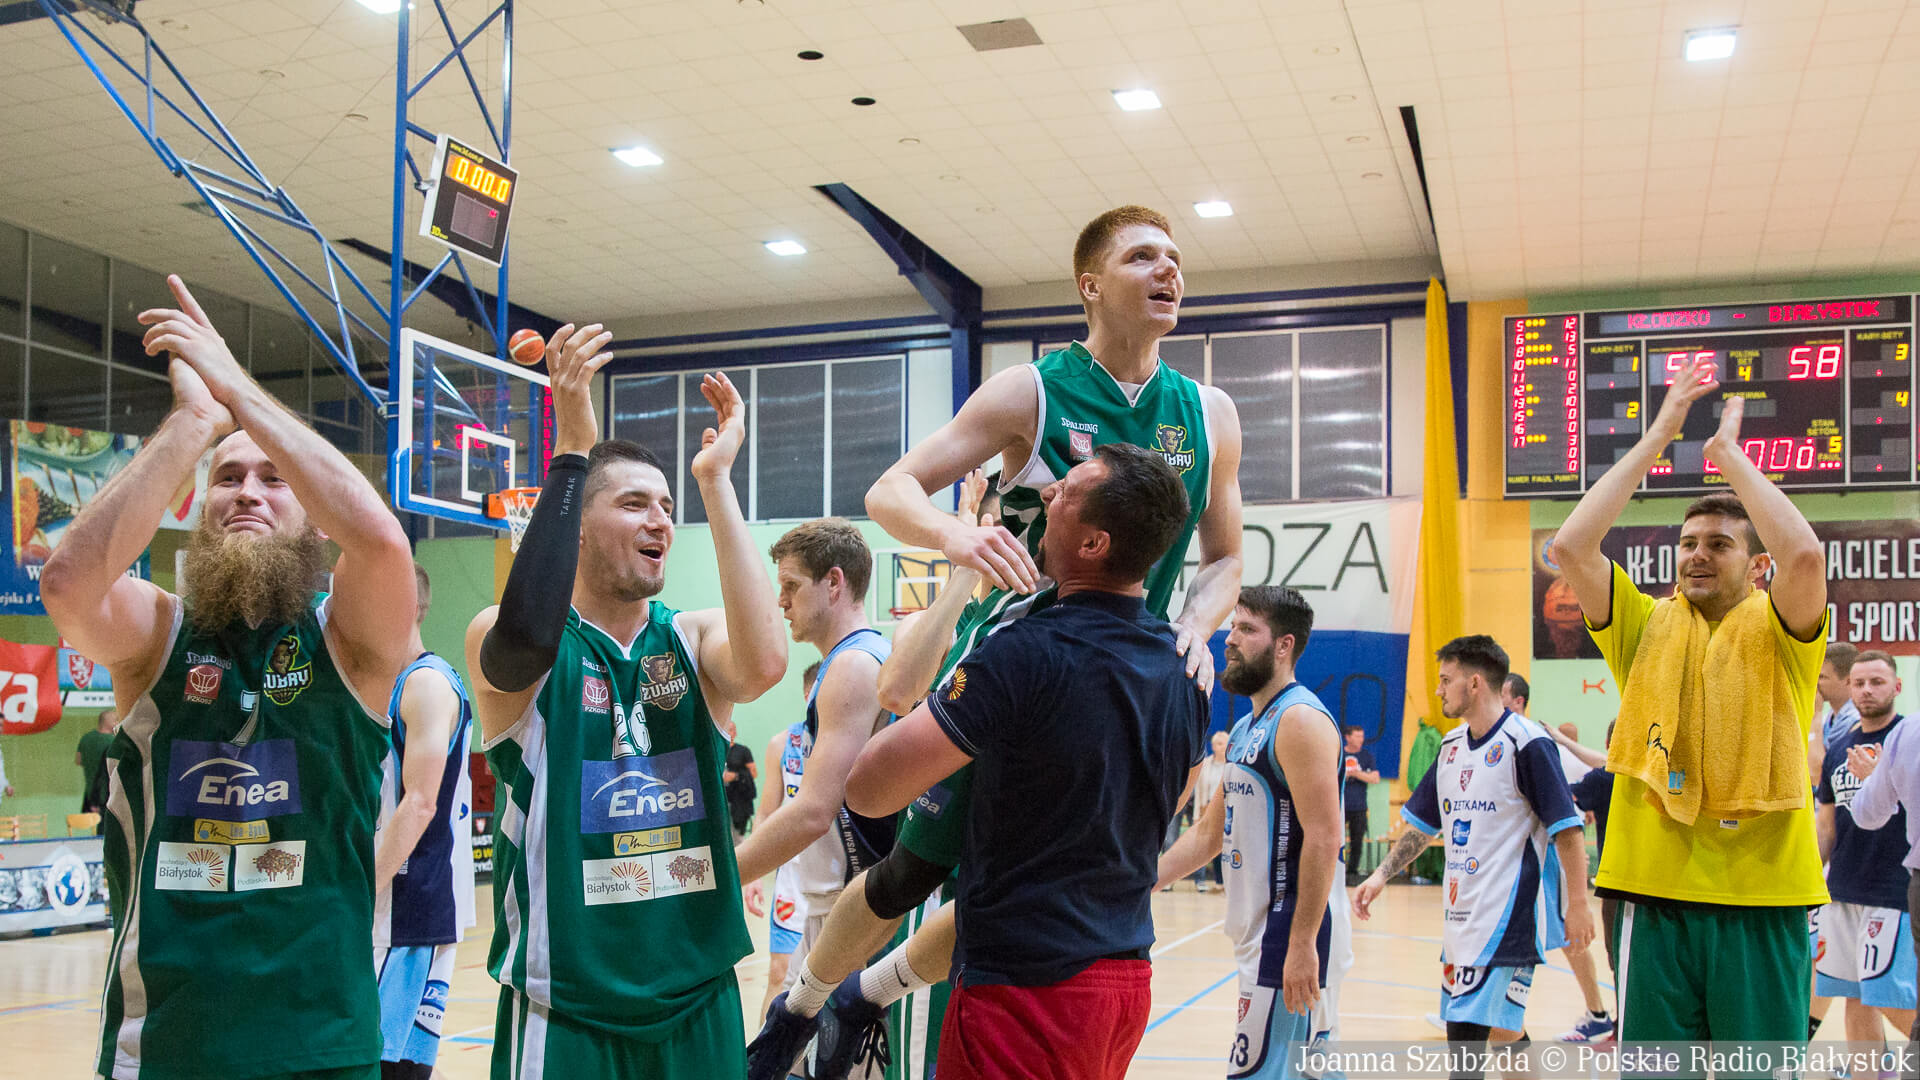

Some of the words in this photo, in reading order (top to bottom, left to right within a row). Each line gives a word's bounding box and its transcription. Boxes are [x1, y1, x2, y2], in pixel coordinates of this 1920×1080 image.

[1627, 309, 1711, 330] KŁODZKO
[1768, 300, 1881, 323] BIAŁYSTOK
[1894, 343, 1909, 361] 3
[1631, 356, 1639, 372] 1
[1787, 345, 1843, 381] 58
[1738, 365, 1752, 382] 4
[1894, 390, 1909, 408] 4
[1625, 401, 1640, 419] 2
[1061, 417, 1098, 434] SPALDING
[1829, 435, 1842, 453] 5
[560, 477, 576, 517] TARMAK
[197, 775, 289, 807] Enea
[608, 788, 694, 818] Enea
[1453, 800, 1497, 813] ZETKAMA
[159, 866, 203, 880] Białystok
[586, 880, 631, 895] Białystok
[1864, 943, 1878, 971] 11
